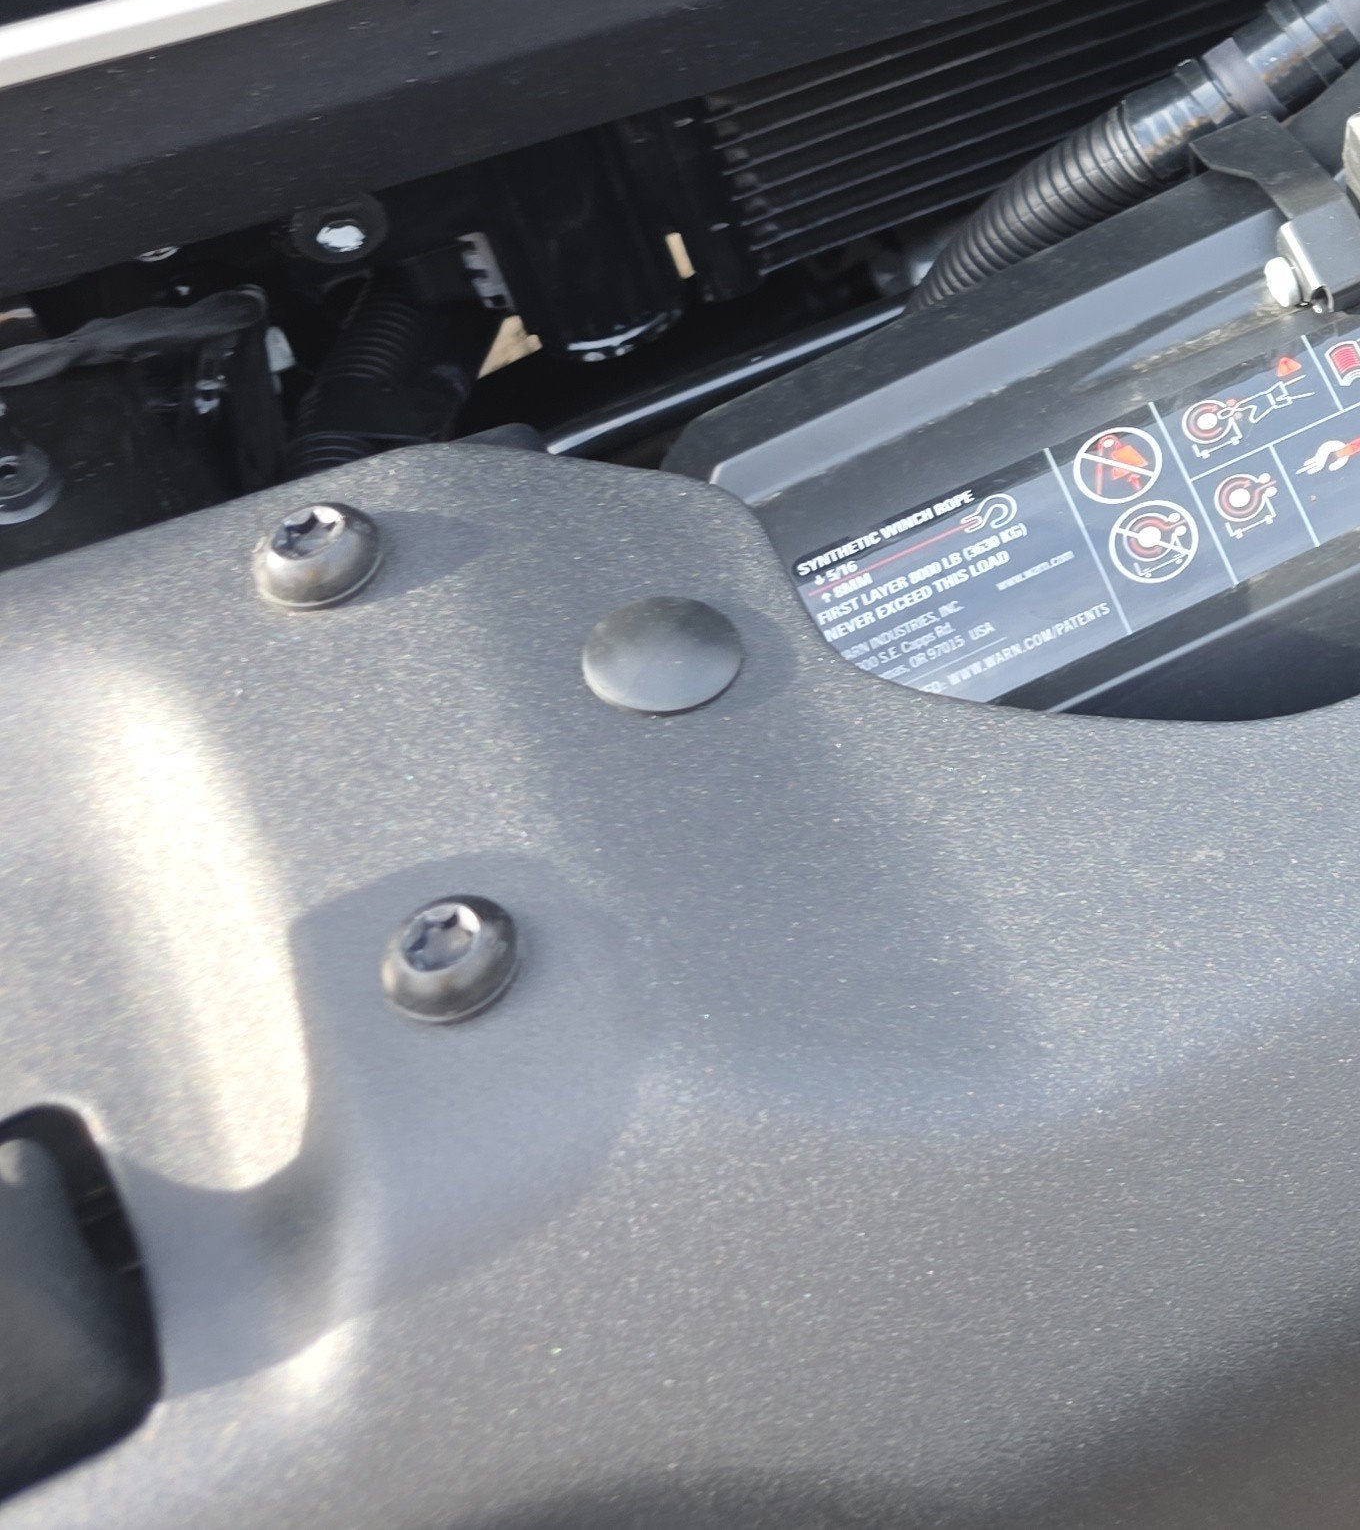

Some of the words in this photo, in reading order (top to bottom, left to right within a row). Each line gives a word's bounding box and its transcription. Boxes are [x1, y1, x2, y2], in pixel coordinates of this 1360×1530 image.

[797, 531, 881, 576] SYNTHETIC
[879, 508, 935, 539] WINCH
[932, 489, 975, 516] ROPE
[817, 597, 859, 625] FIRST
[861, 576, 909, 605] LAYER
[908, 562, 941, 584] 8000
[942, 552, 963, 569] LB
[999, 523, 1027, 543] KG)
[823, 611, 876, 642] NEVER
[875, 585, 933, 619] EXCEED
[932, 569, 969, 592] THIS
[968, 550, 1010, 577] LOAD
[826, 561, 858, 582] 5/16
[832, 572, 873, 598] 8MM
[901, 632, 937, 653] Capps
[934, 622, 956, 638] Rd.
[909, 652, 929, 668] OR
[927, 634, 966, 661] 97015
[968, 622, 996, 641] USA
[947, 602, 1111, 686] WWW.WARN.COM/PATENTS
